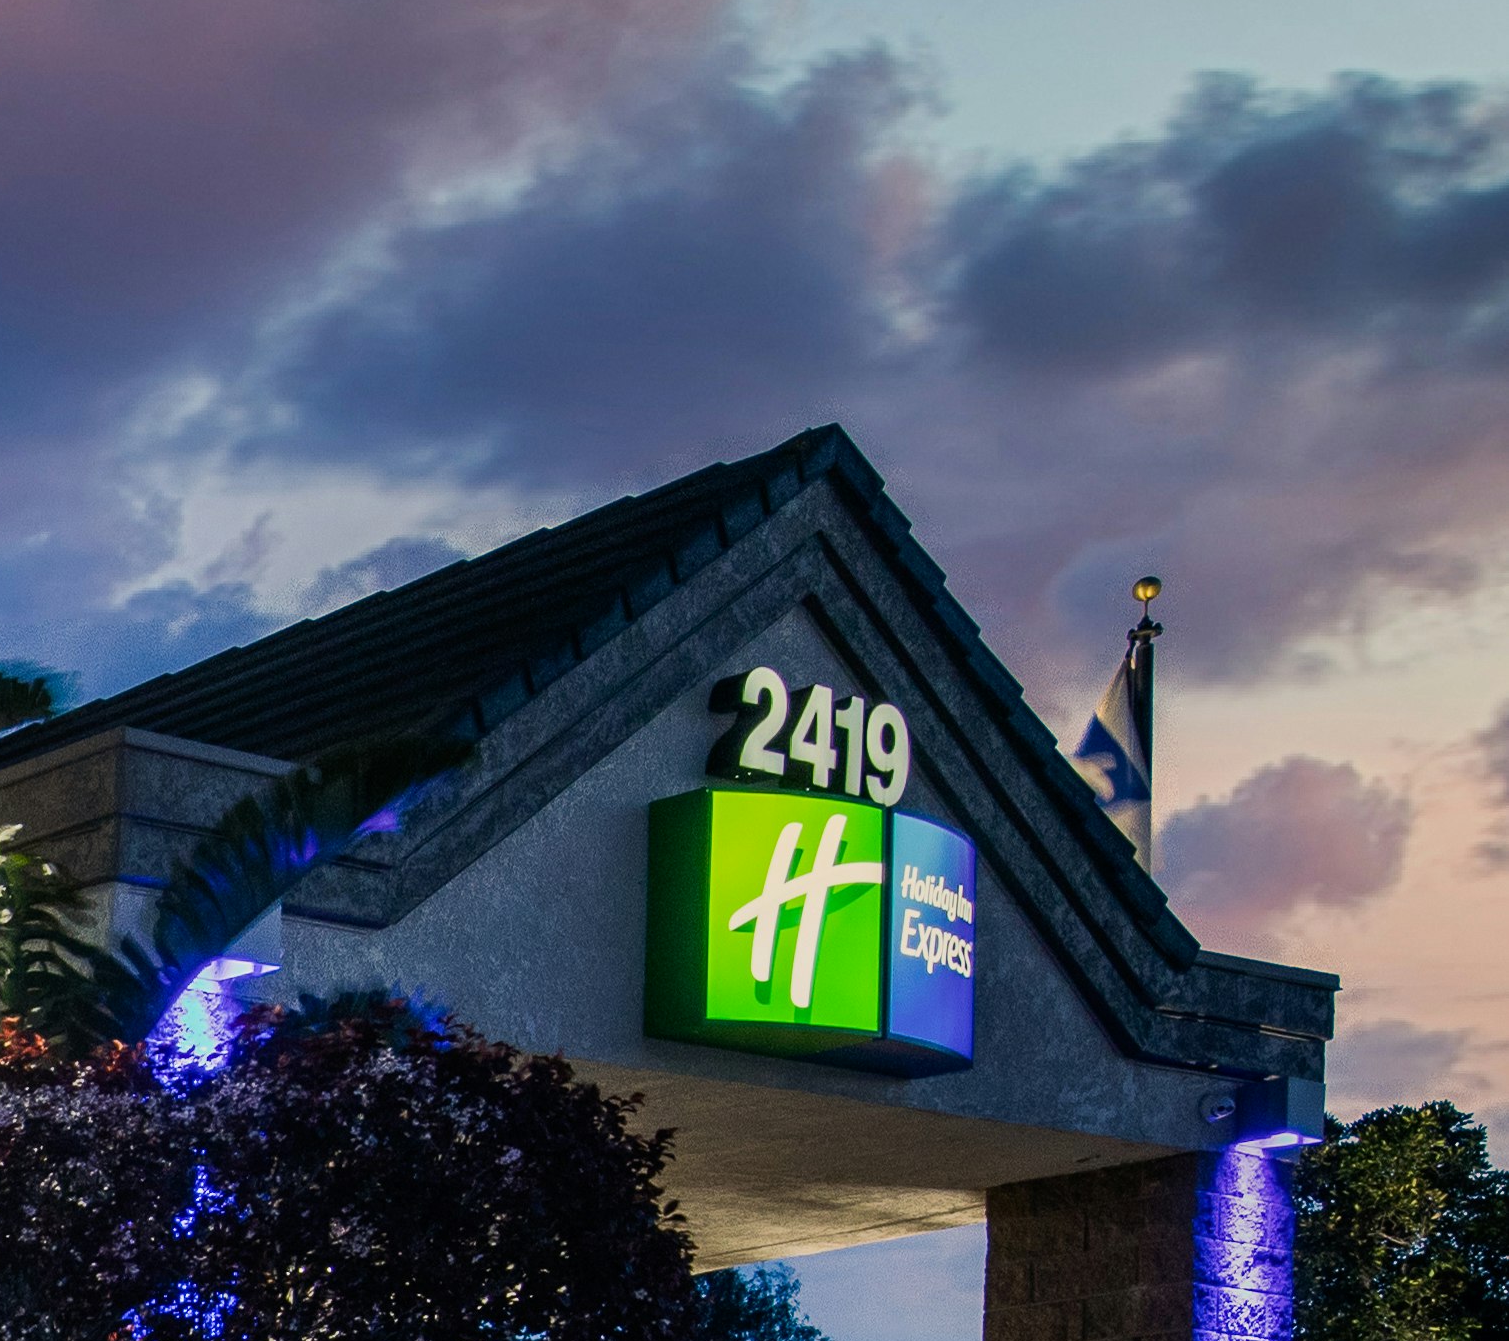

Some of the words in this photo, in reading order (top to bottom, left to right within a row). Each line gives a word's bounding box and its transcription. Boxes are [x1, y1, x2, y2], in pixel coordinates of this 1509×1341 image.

[738, 665, 910, 808] 2419
[901, 864, 958, 923] Holiday
[957, 884, 973, 925] Inn
[900, 908, 973, 978] Express
